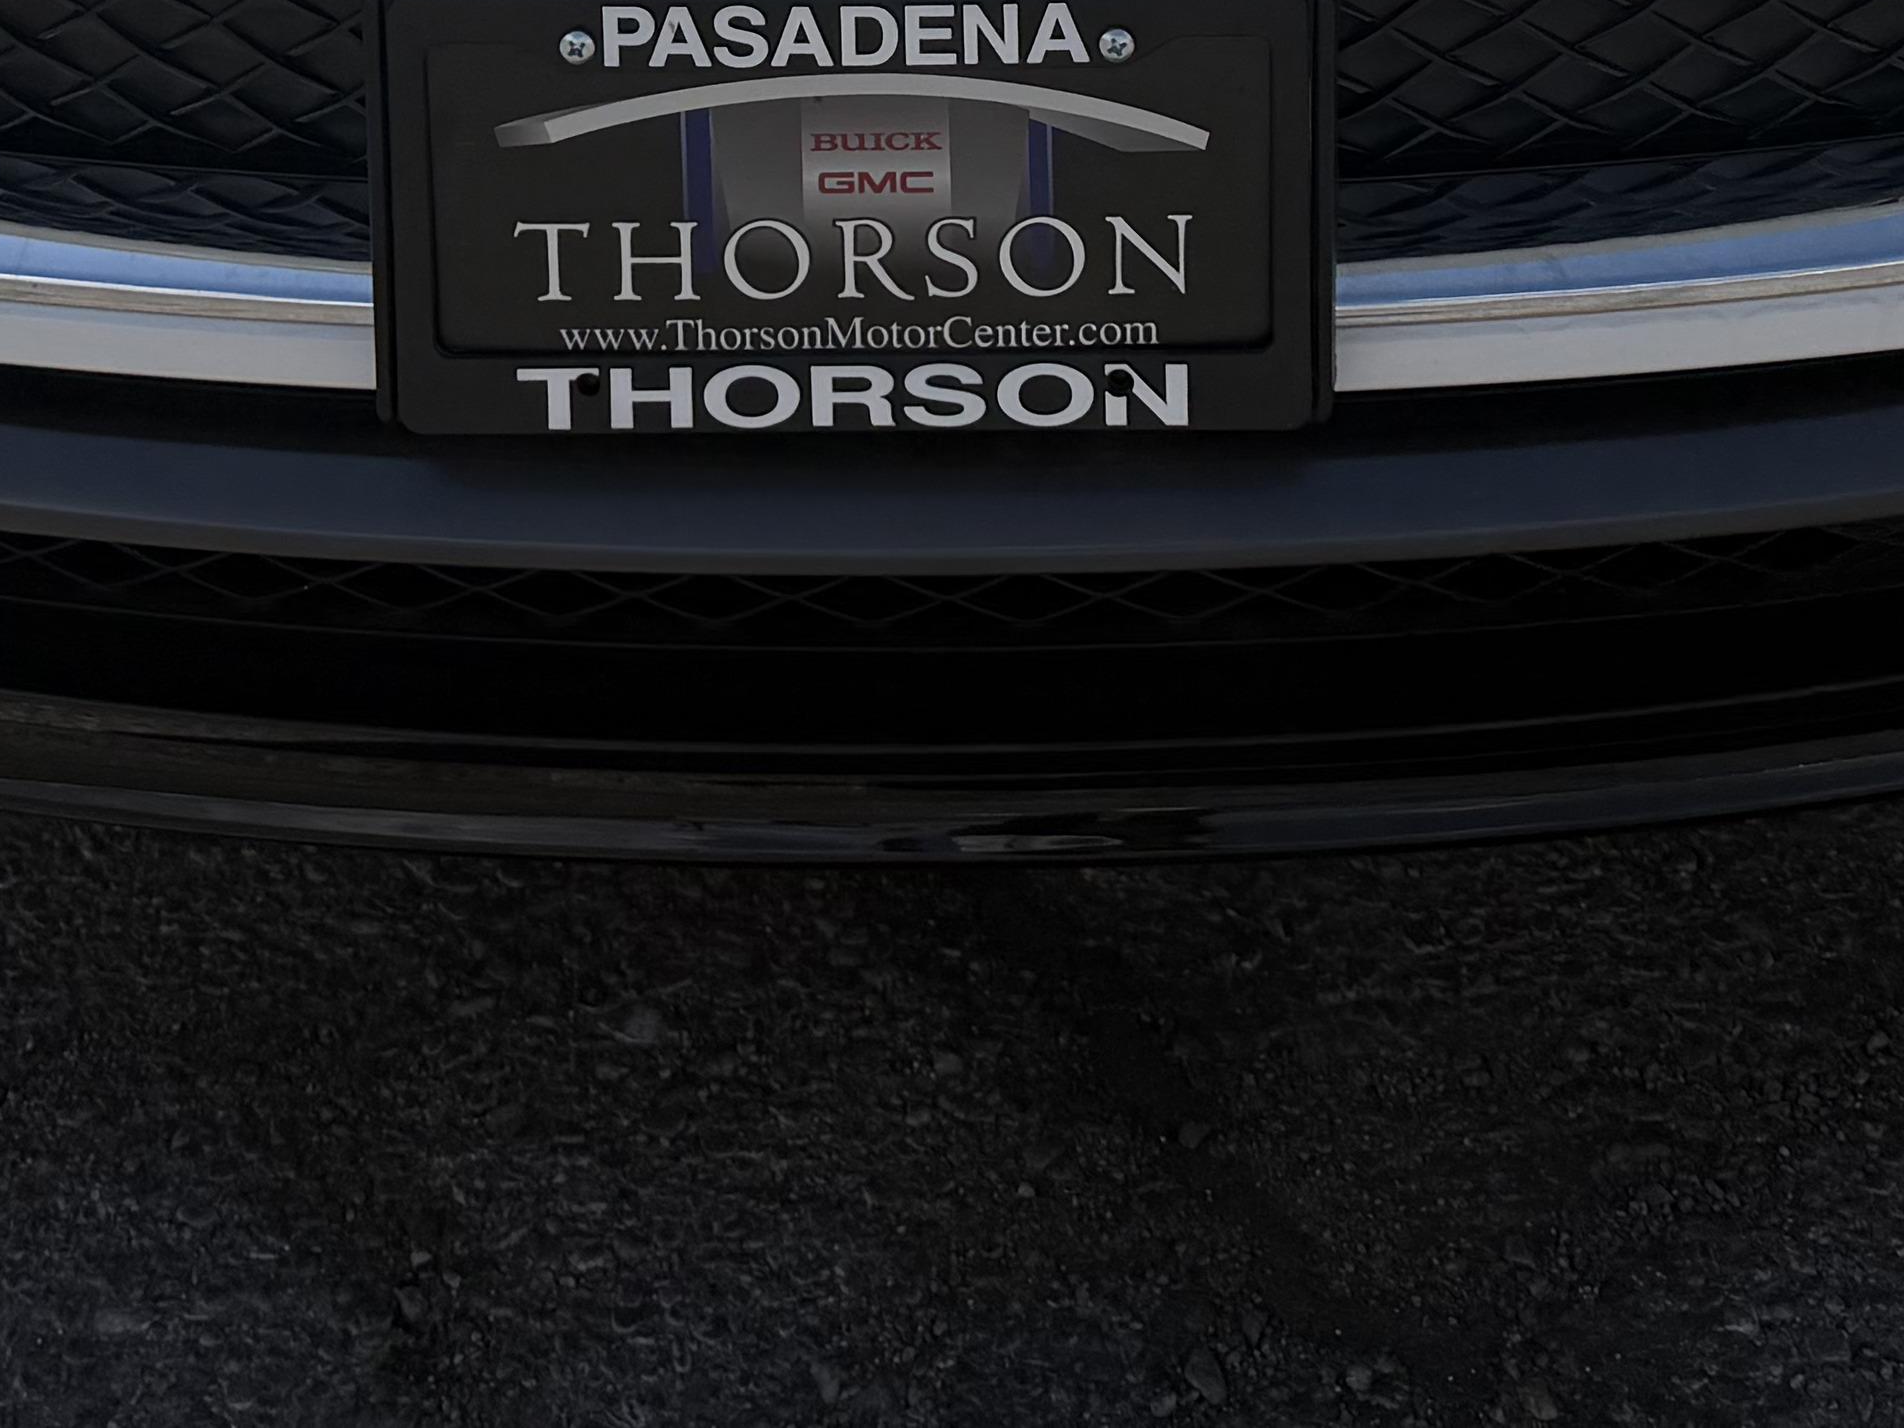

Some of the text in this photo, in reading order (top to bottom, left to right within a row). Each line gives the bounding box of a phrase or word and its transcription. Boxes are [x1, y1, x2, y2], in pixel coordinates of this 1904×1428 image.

[601, 2, 1091, 69] PASADENA
[810, 131, 943, 153] BUICK
[818, 171, 935, 195] GMC
[513, 214, 1193, 301] THORSON
[559, 315, 1160, 351] www.ThorsonMotorCenter.com
[516, 363, 1190, 431] THORSON
